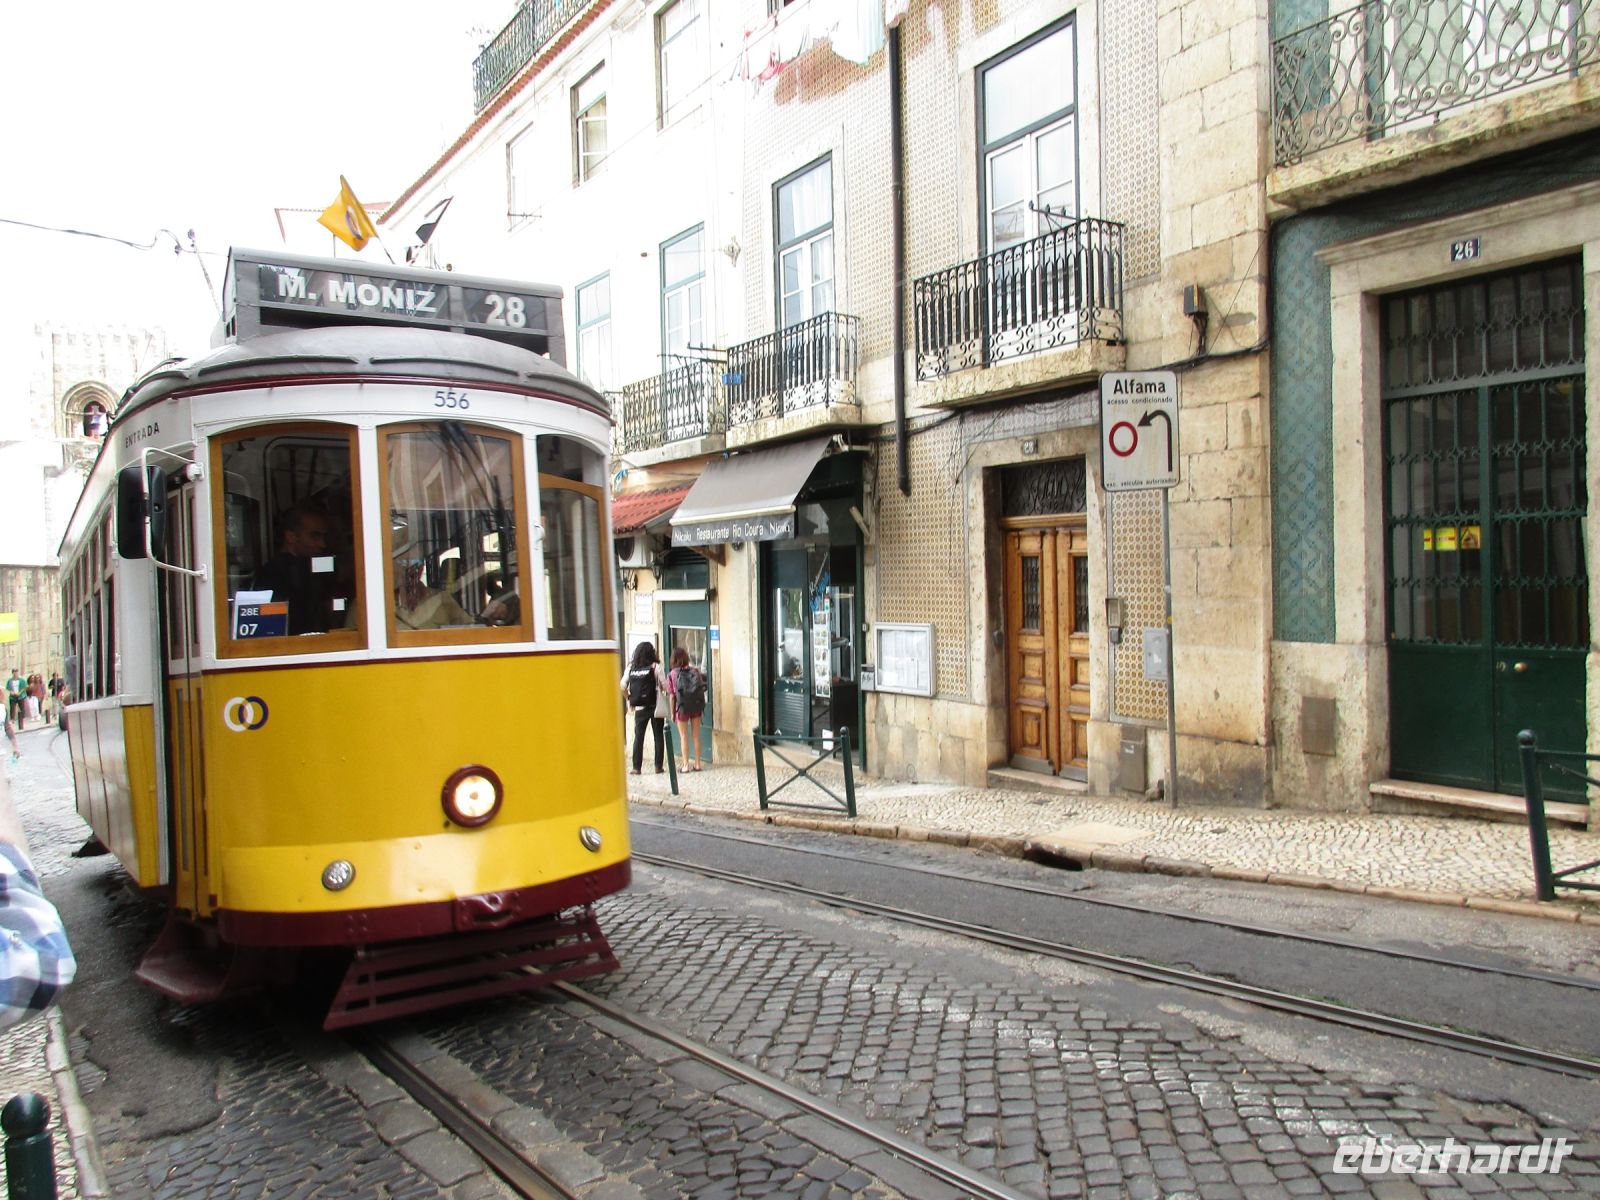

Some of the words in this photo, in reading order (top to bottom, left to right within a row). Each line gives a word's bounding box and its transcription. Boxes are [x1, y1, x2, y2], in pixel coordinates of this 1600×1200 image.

[1454, 240, 1474, 260] 26
[278, 274, 317, 300] M.
[329, 279, 437, 313] MONIZ
[485, 294, 526, 329] 28
[1113, 379, 1166, 395] Alfama
[434, 391, 470, 410] 556
[1131, 396, 1173, 404] condicionado
[125, 422, 160, 448] ENTRADA
[696, 526, 730, 540] Restaurante
[732, 523, 742, 538] Rio
[744, 521, 764, 537] Coura
[240, 607, 259, 617] 28E
[240, 623, 259, 636] 07
